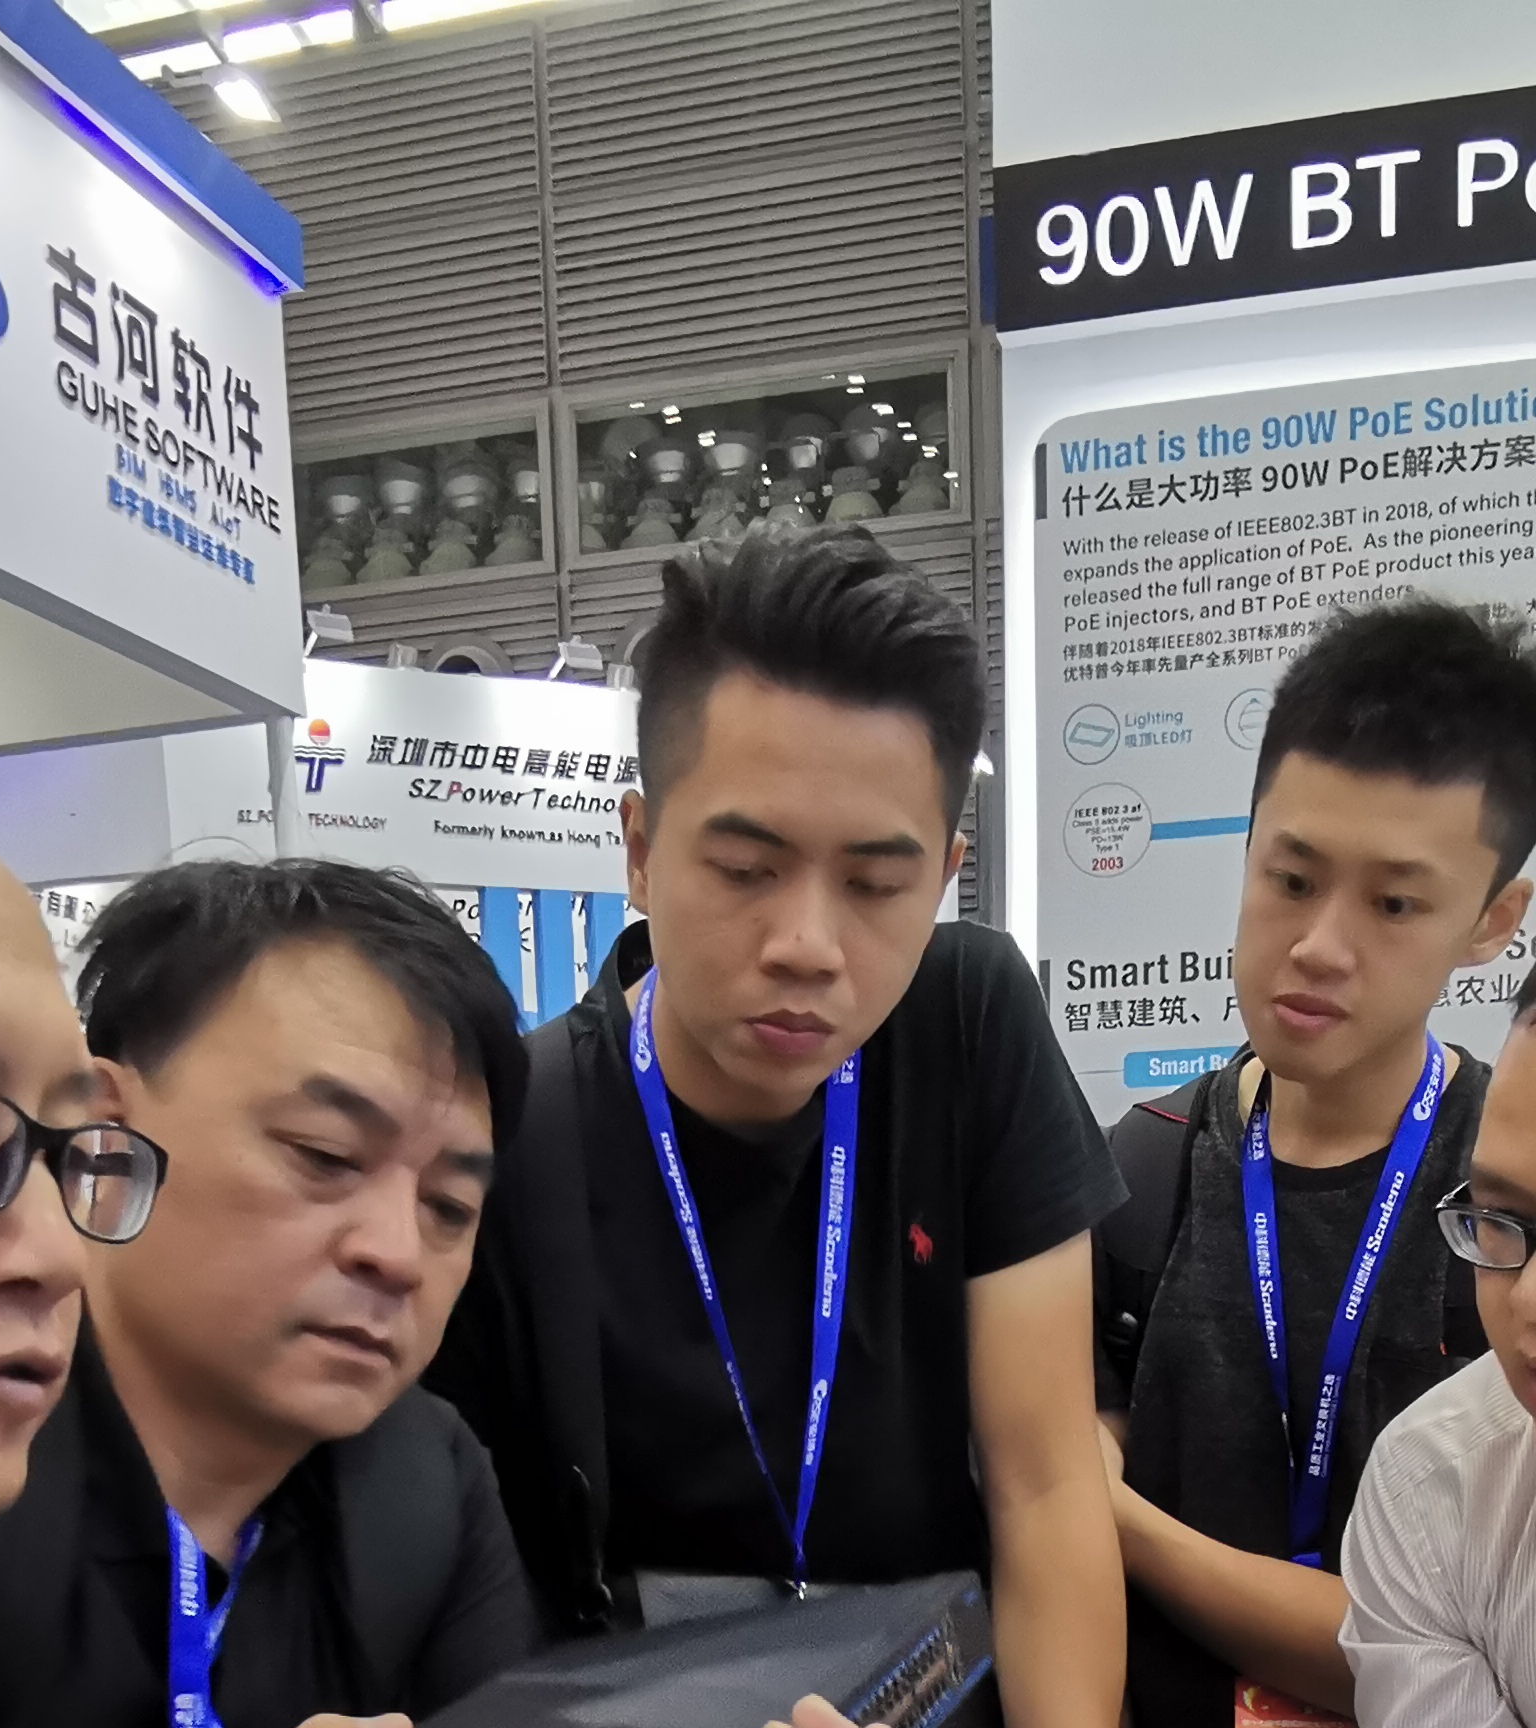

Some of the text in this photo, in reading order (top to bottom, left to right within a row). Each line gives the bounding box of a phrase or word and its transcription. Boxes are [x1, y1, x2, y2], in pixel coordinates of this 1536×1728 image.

[1035, 172, 1256, 287] 90W
[1290, 149, 1422, 251] BT
[47, 242, 263, 470] 古河软件
[55, 360, 282, 535] GUHE SOFTWARE
[1059, 429, 1148, 476] What
[1157, 427, 1185, 463] is
[1197, 424, 1252, 458] the
[1260, 410, 1336, 451] 90W
[1349, 400, 1415, 441] PoE
[1062, 465, 1253, 520] 什么是大功率
[1261, 460, 1331, 493] 90W
[1063, 536, 1105, 558] With
[1110, 532, 1139, 552] the
[1143, 525, 1210, 550] release
[1214, 522, 1234, 542] of
[1236, 508, 1358, 539] IEEE802.3BT
[1362, 506, 1381, 525] in
[1384, 500, 1434, 525] 2018,
[1438, 497, 1459, 516] of
[1461, 490, 1521, 513] which
[1063, 560, 1141, 586] expands
[1144, 553, 1174, 573] the
[1177, 543, 1282, 574] application
[1286, 540, 1306, 559] of
[1310, 535, 1354, 556] PoE.
[1363, 530, 1389, 550] As
[1392, 525, 1425, 546] the
[1429, 517, 1535, 547] pioneering
[1063, 584, 1143, 611] released
[1147, 579, 1177, 598] the
[1181, 574, 1212, 595] full
[1215, 568, 1272, 595] range
[1275, 566, 1296, 585] of
[1300, 562, 1329, 583] BT
[1331, 558, 1371, 580] PoE
[1375, 549, 1454, 579] product
[1457, 546, 1494, 568] this
[1064, 611, 1101, 633] PoE
[1105, 606, 1195, 632] injectors,
[1199, 599, 1236, 619] and
[1241, 596, 1268, 615] BT
[1272, 591, 1312, 612] PoE
[1124, 711, 1184, 730] Lighting
[531, 787, 618, 814] Techno
[1073, 808, 1099, 819] IEEE
[1092, 856, 1124, 872] 2003
[1066, 953, 1171, 991] Smart
[1179, 948, 1235, 984] Bui
[1148, 1057, 1205, 1078] Smart
[1367, 1170, 1406, 1253] Scodeno
